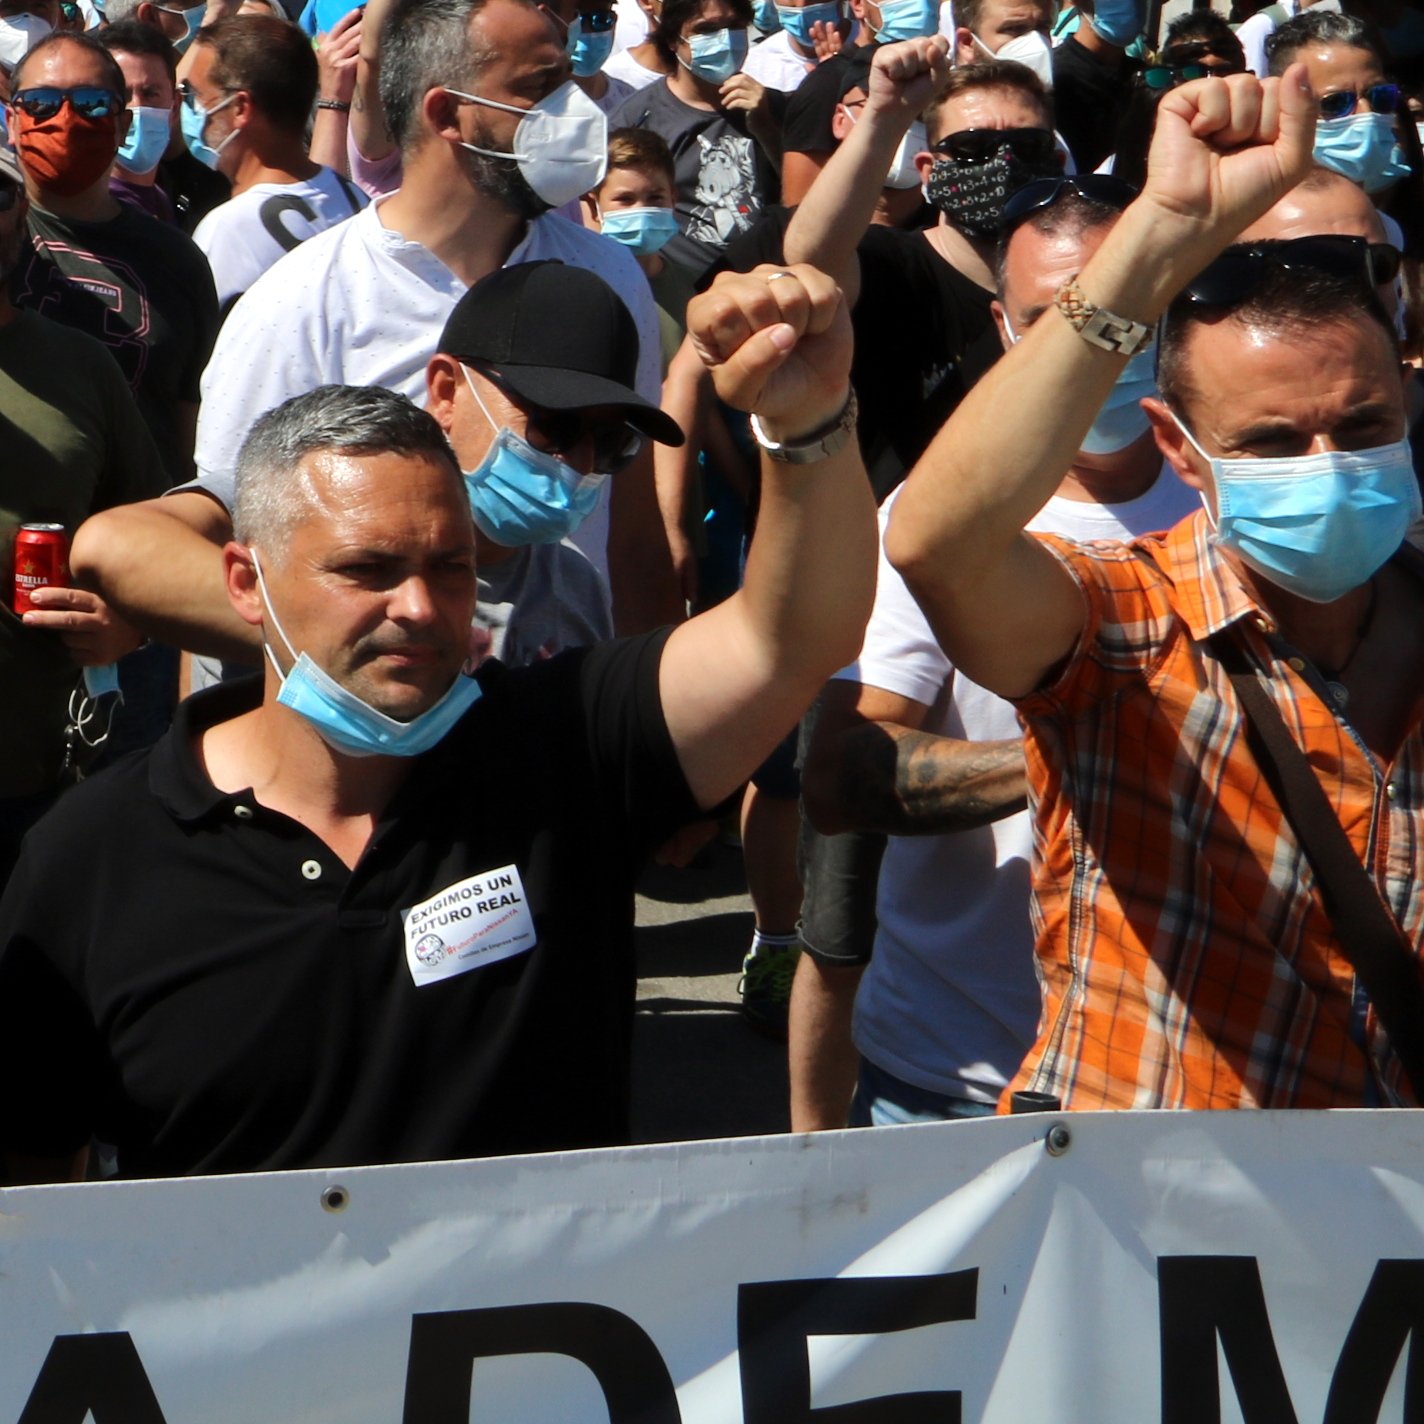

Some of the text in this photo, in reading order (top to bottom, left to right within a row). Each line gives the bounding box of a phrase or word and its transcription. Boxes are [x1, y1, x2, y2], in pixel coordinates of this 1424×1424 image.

[411, 874, 513, 925] EXIGIMOS UN
[411, 892, 521, 940] FUTURO REAL
